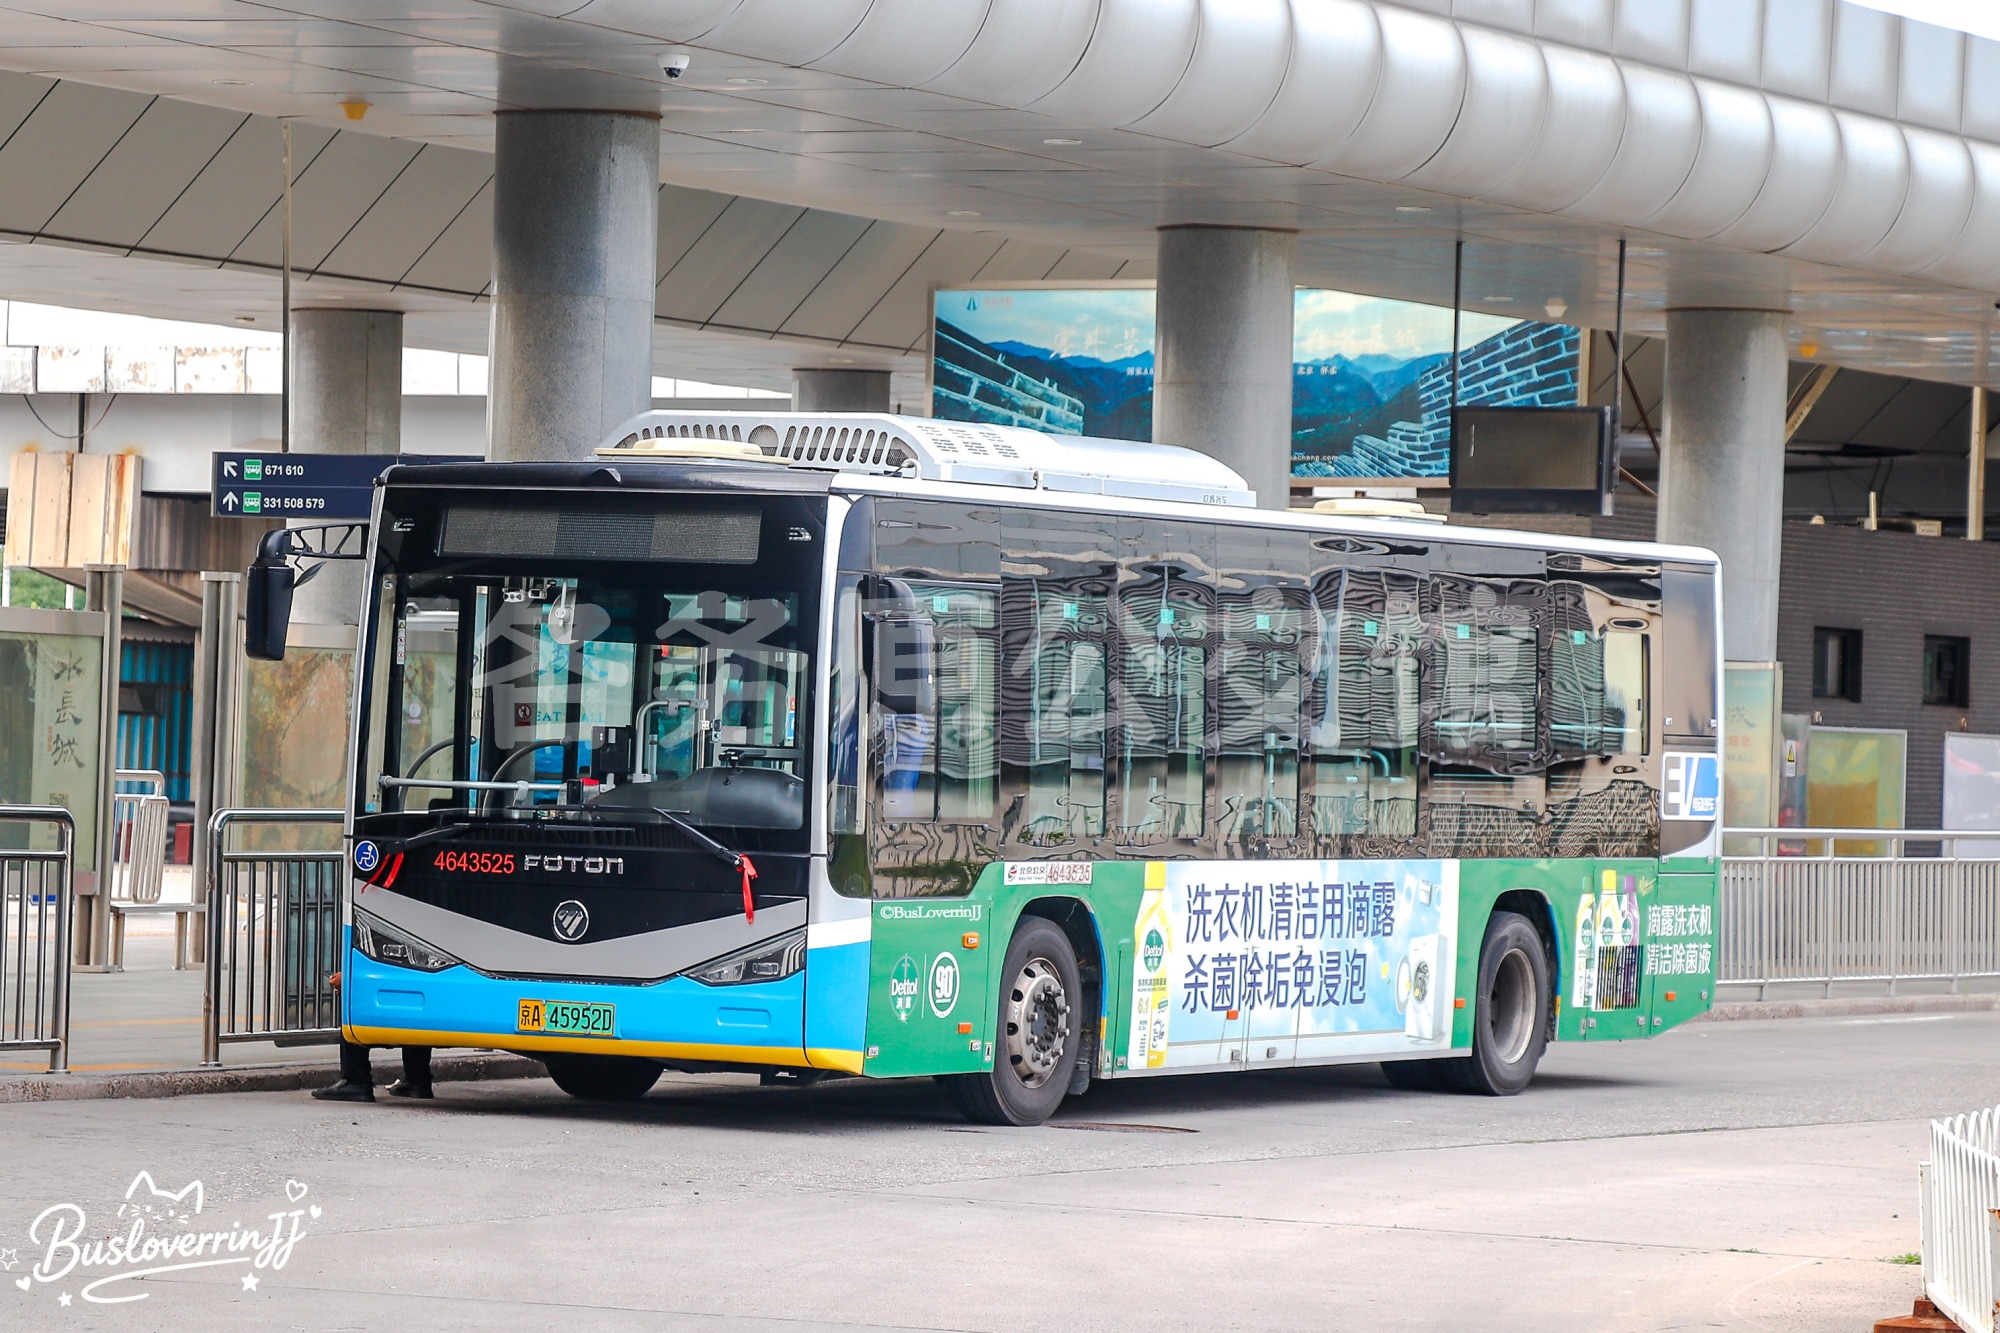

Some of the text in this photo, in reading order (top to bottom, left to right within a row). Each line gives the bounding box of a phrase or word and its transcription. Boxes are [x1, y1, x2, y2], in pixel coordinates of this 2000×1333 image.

[264, 464, 304, 476] 671 610
[263, 497, 325, 509] 331 508 579
[434, 851, 625, 875] 4643525 FOTON
[1047, 864, 1091, 883] 4643525
[1186, 881, 1396, 944] 洗衣机清洁用滴露
[1647, 904, 1713, 937] 滴露洗衣机
[1144, 944, 1164, 957] Dettol
[1645, 942, 1712, 976] 清洁除菌液
[891, 977, 918, 996] Dettol
[935, 965, 955, 999] 90
[1182, 949, 1368, 1014] 杀菌除垢免浸泡
[519, 1005, 613, 1031] 京A 45952D
